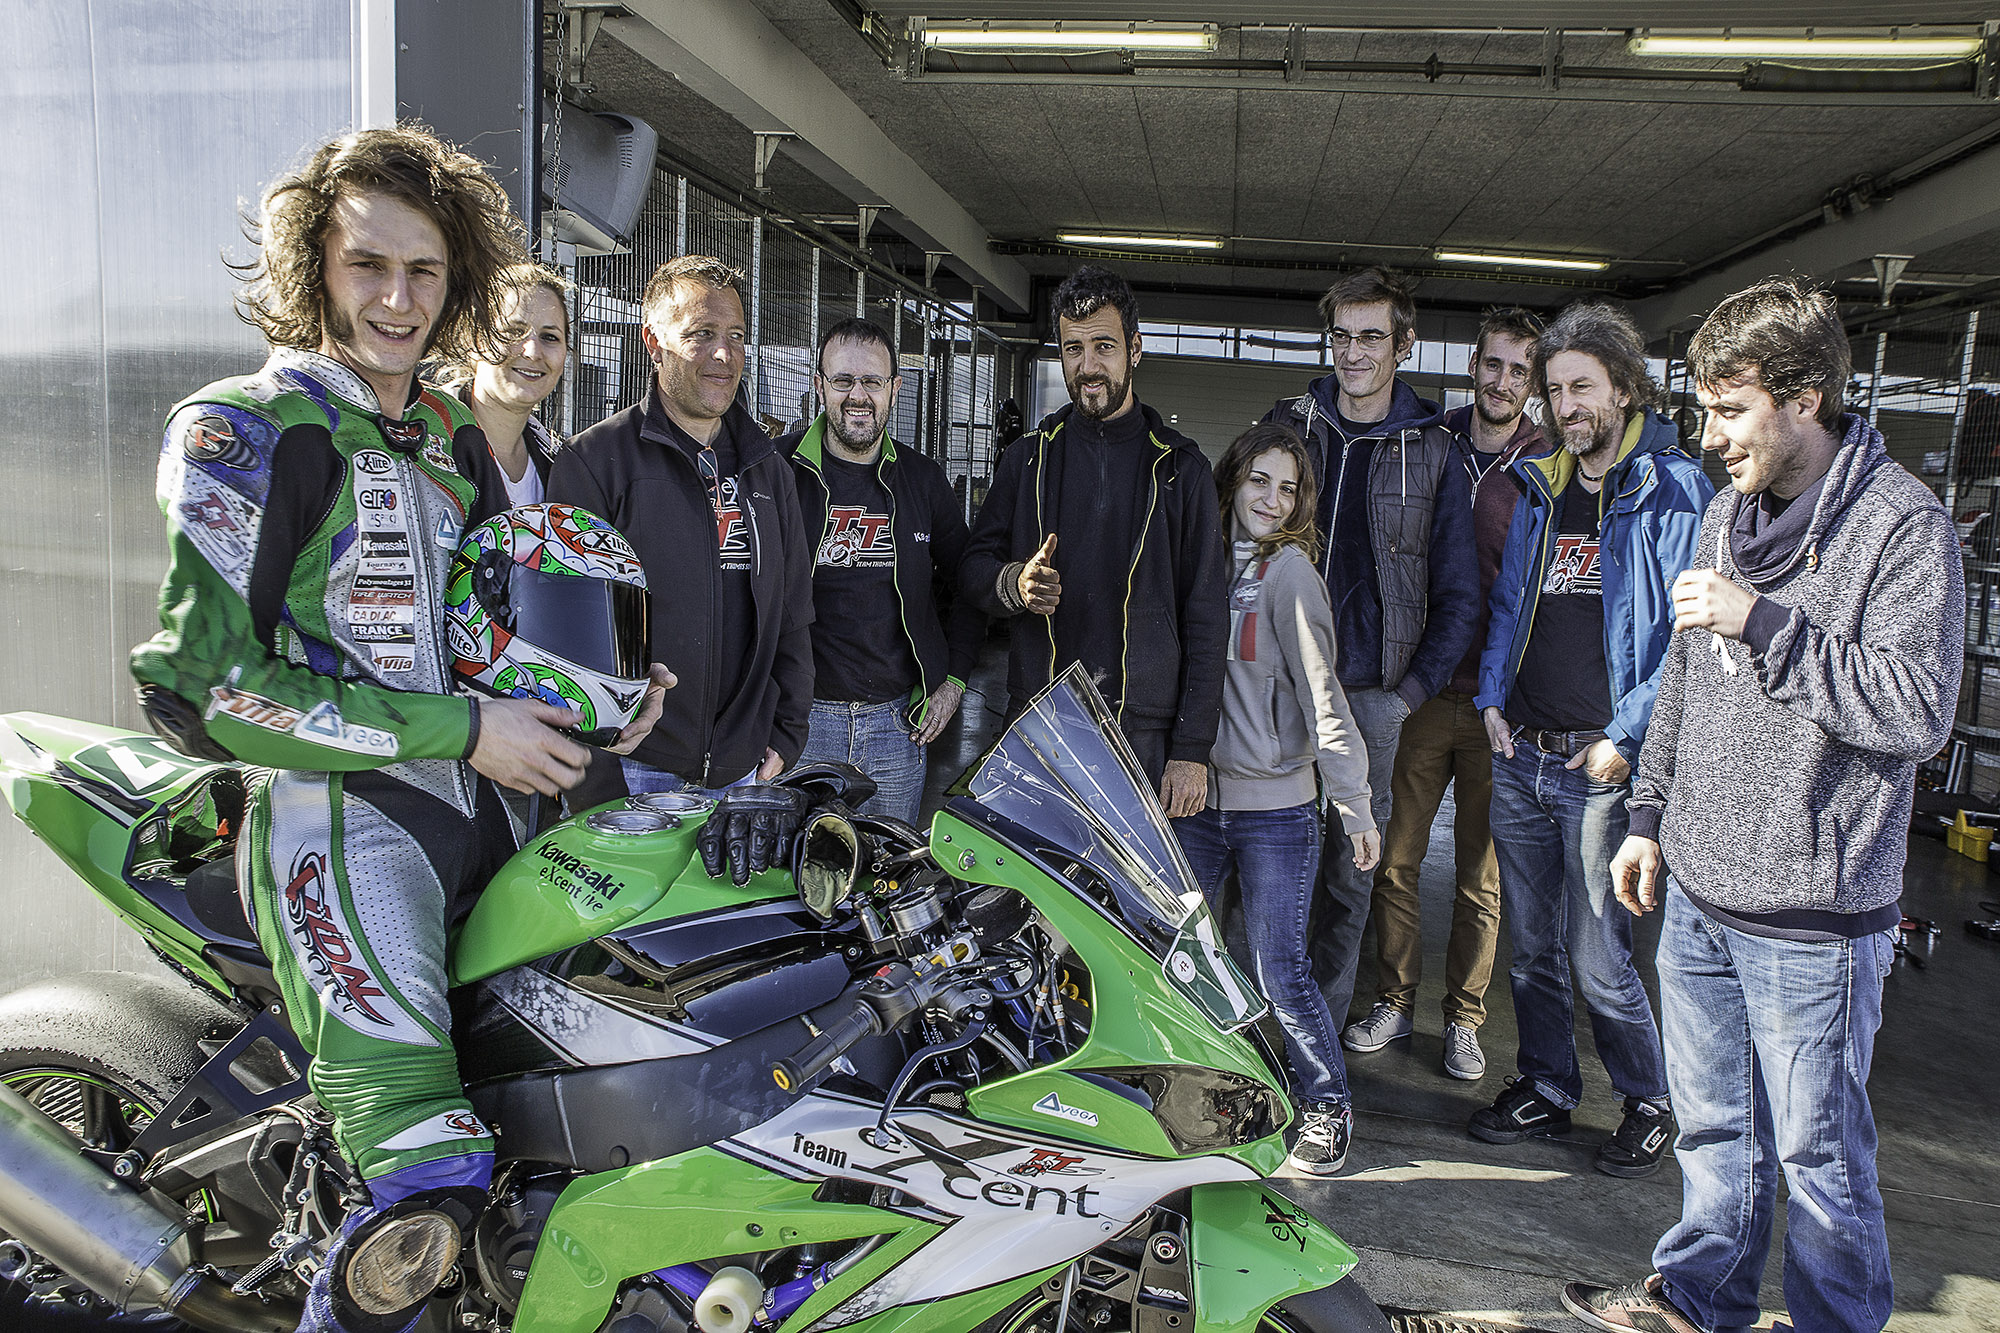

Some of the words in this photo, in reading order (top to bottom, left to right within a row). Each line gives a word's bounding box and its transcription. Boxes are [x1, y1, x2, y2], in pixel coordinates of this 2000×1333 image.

[361, 454, 389, 471] X-lite
[362, 539, 408, 551] Kawasaki
[594, 534, 636, 556] X-lite
[350, 625, 403, 635] FRANCE
[384, 659, 413, 670] Vija
[228, 697, 297, 729] Vija
[535, 840, 625, 901] Kawasaki
[792, 1131, 848, 1169] Team
